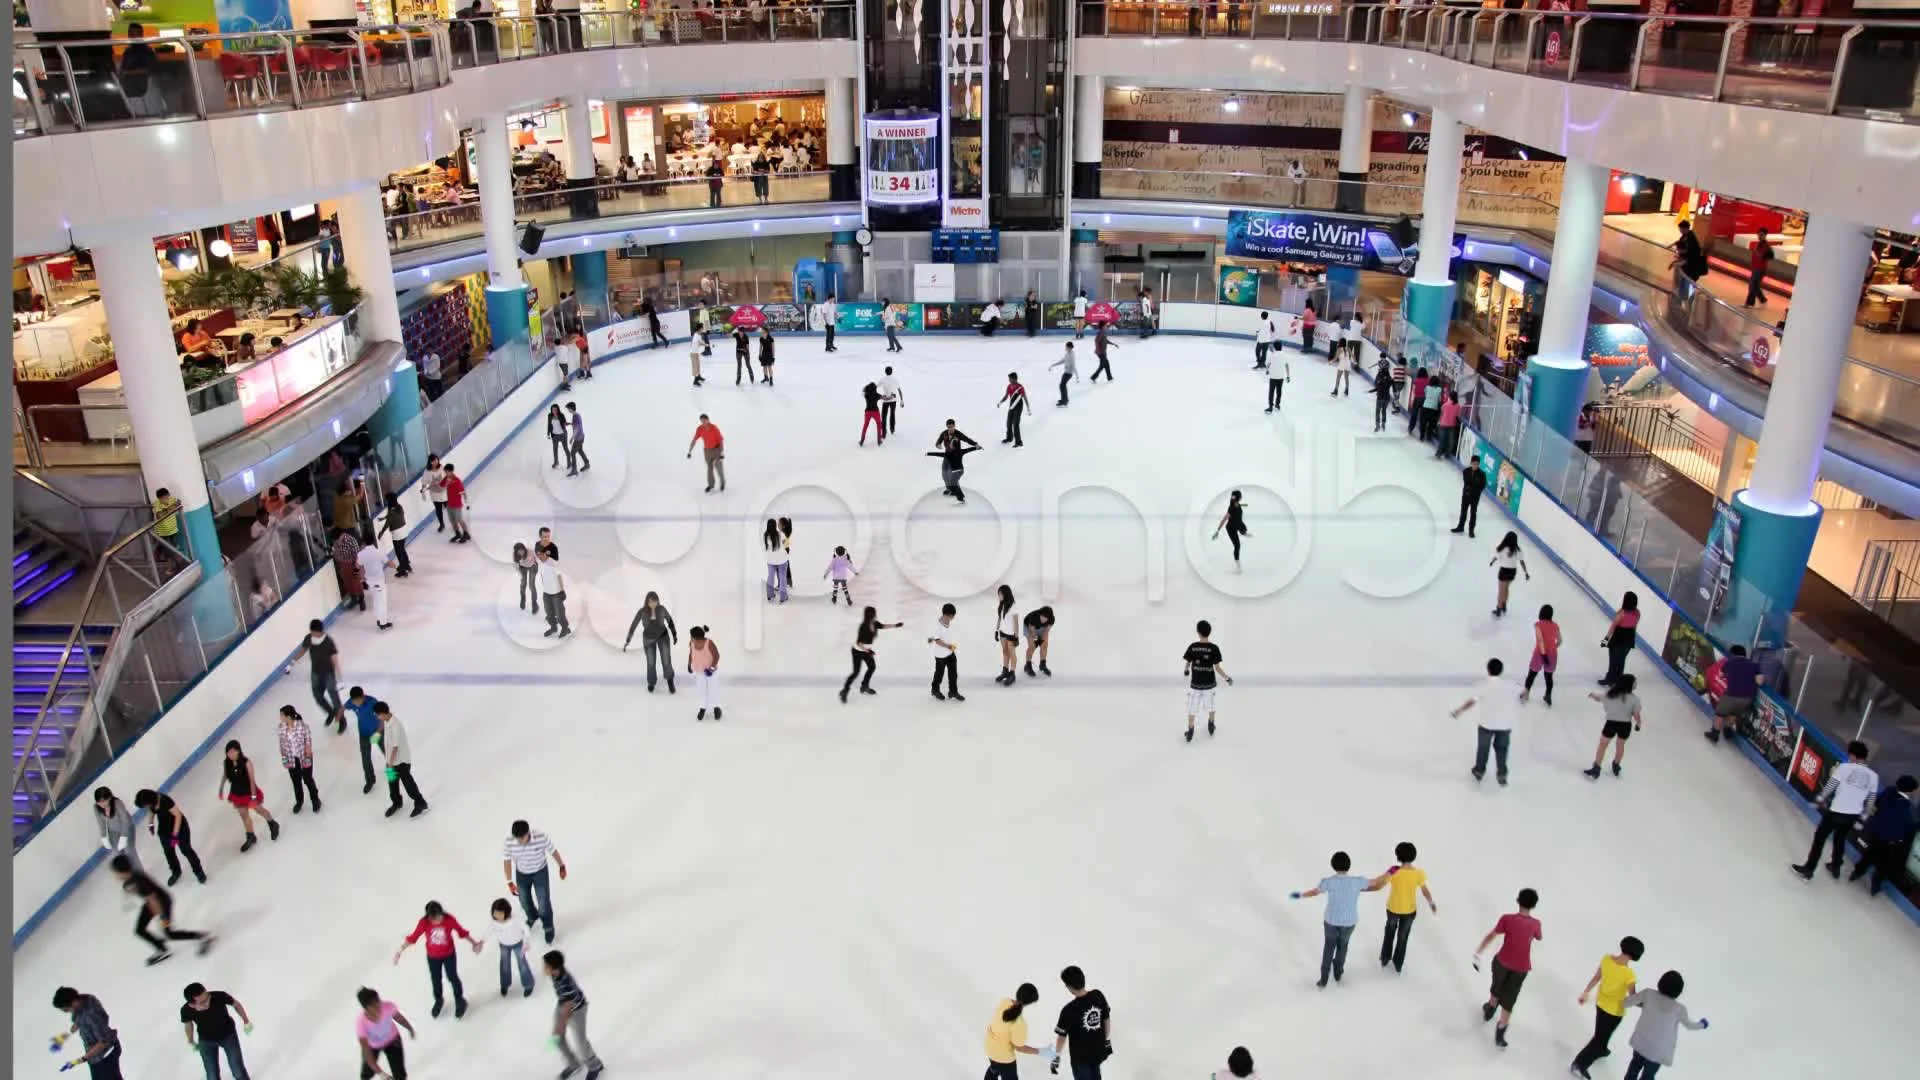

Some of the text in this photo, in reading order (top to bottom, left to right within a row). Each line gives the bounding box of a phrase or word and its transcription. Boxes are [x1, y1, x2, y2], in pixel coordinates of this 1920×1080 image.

[877, 128, 926, 137] A WINNER
[1407, 136, 1430, 151] Piz
[1114, 147, 1144, 158] better
[1369, 161, 1420, 174] pgrading
[1470, 167, 1490, 177] you
[1494, 167, 1530, 178] better
[889, 176, 911, 191] 34
[1245, 242, 1259, 251] Win
[1284, 246, 1318, 258] Samsung
[1319, 250, 1345, 261] Galaxy
[1347, 253, 1352, 261] S
[855, 309, 872, 318] FOX
[1753, 342, 1768, 359] LG2
